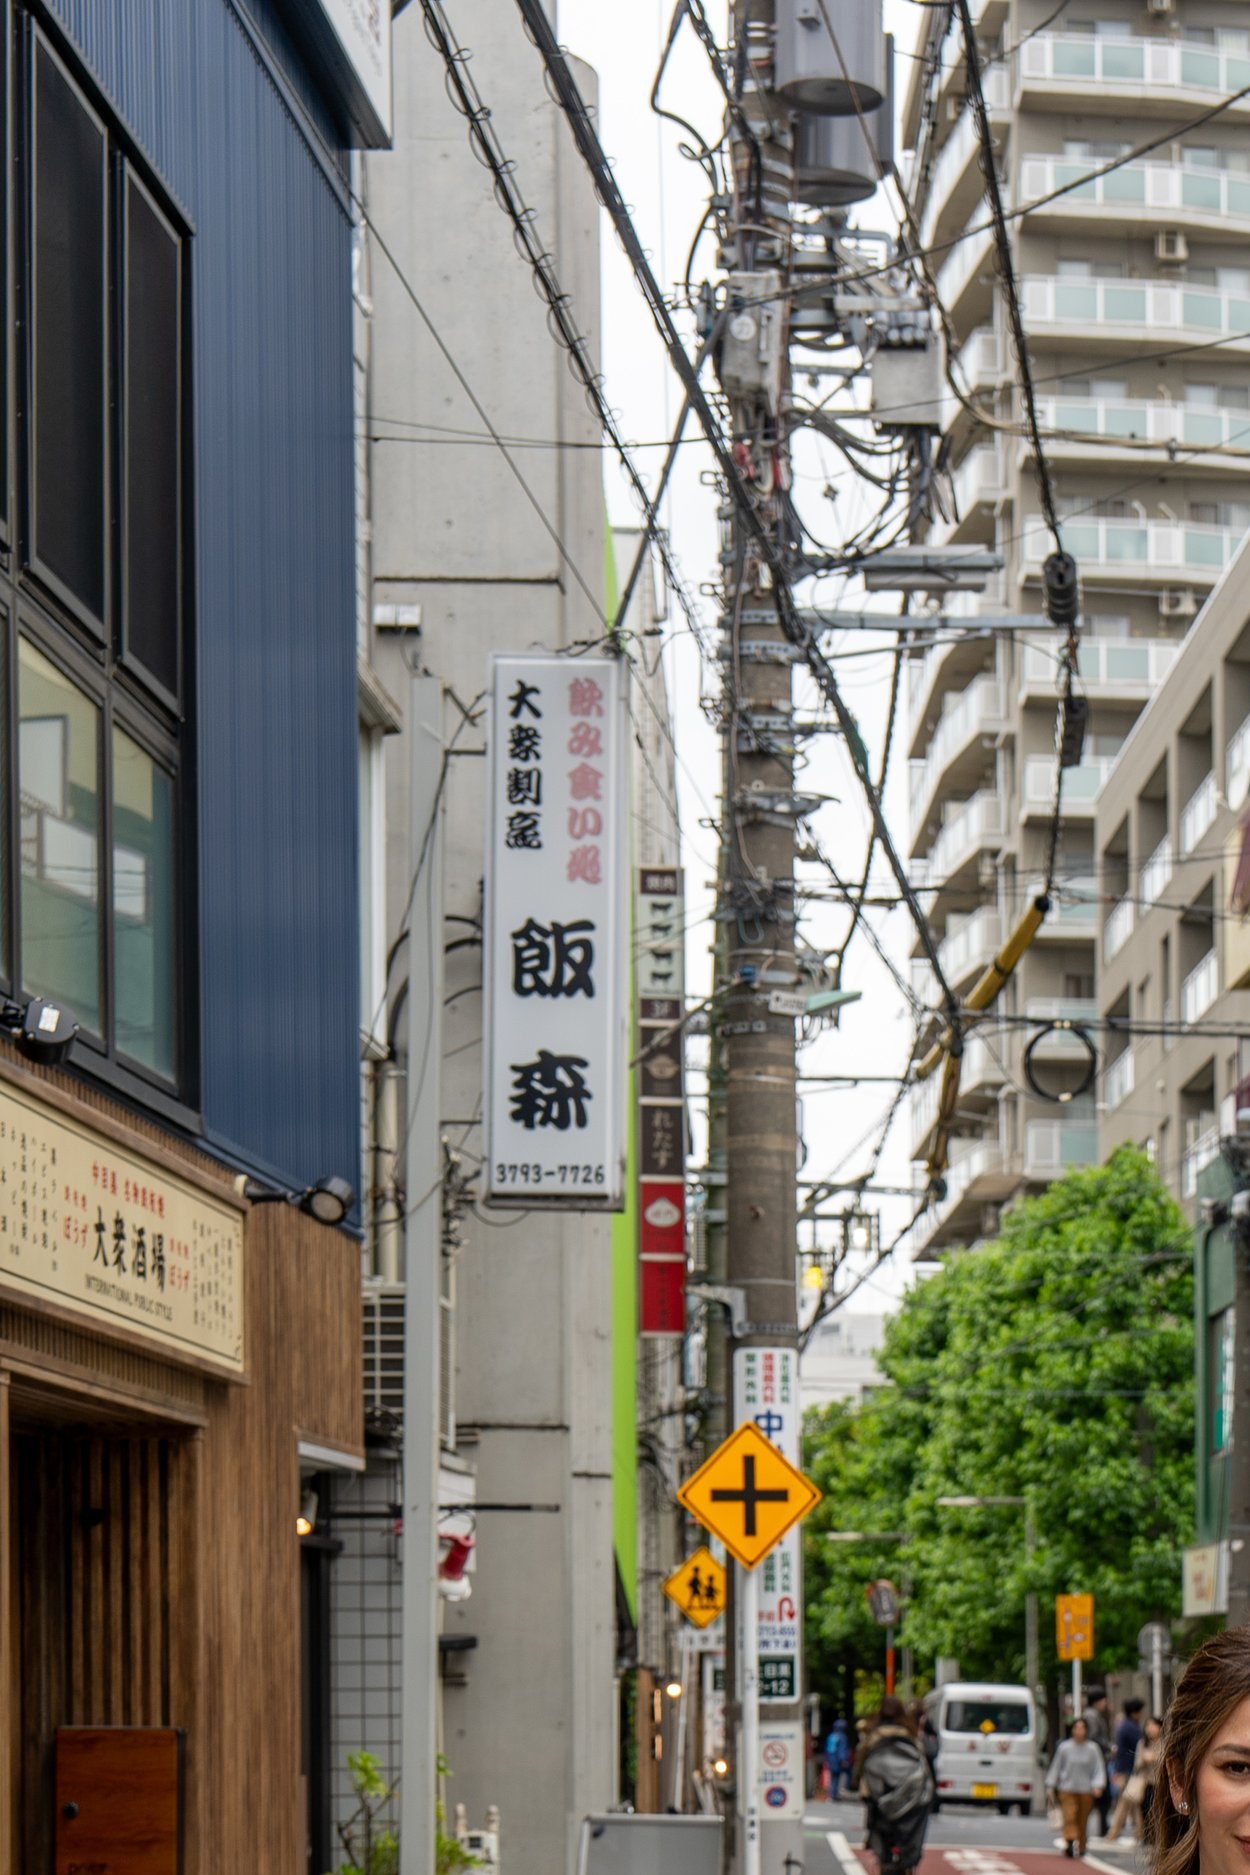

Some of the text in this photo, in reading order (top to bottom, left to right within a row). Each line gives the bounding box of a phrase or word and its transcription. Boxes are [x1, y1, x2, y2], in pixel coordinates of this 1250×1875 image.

[505, 679, 543, 850] 大衆割烹
[568, 677, 604, 885] 飲み食い処
[508, 917, 597, 1132] 飯森
[496, 1162, 606, 1185] 3793-7726
[85, 1273, 173, 1322] INTERNATIONAL PUBLIC STYLE
[93, 1205, 167, 1294] 大衆酒場
